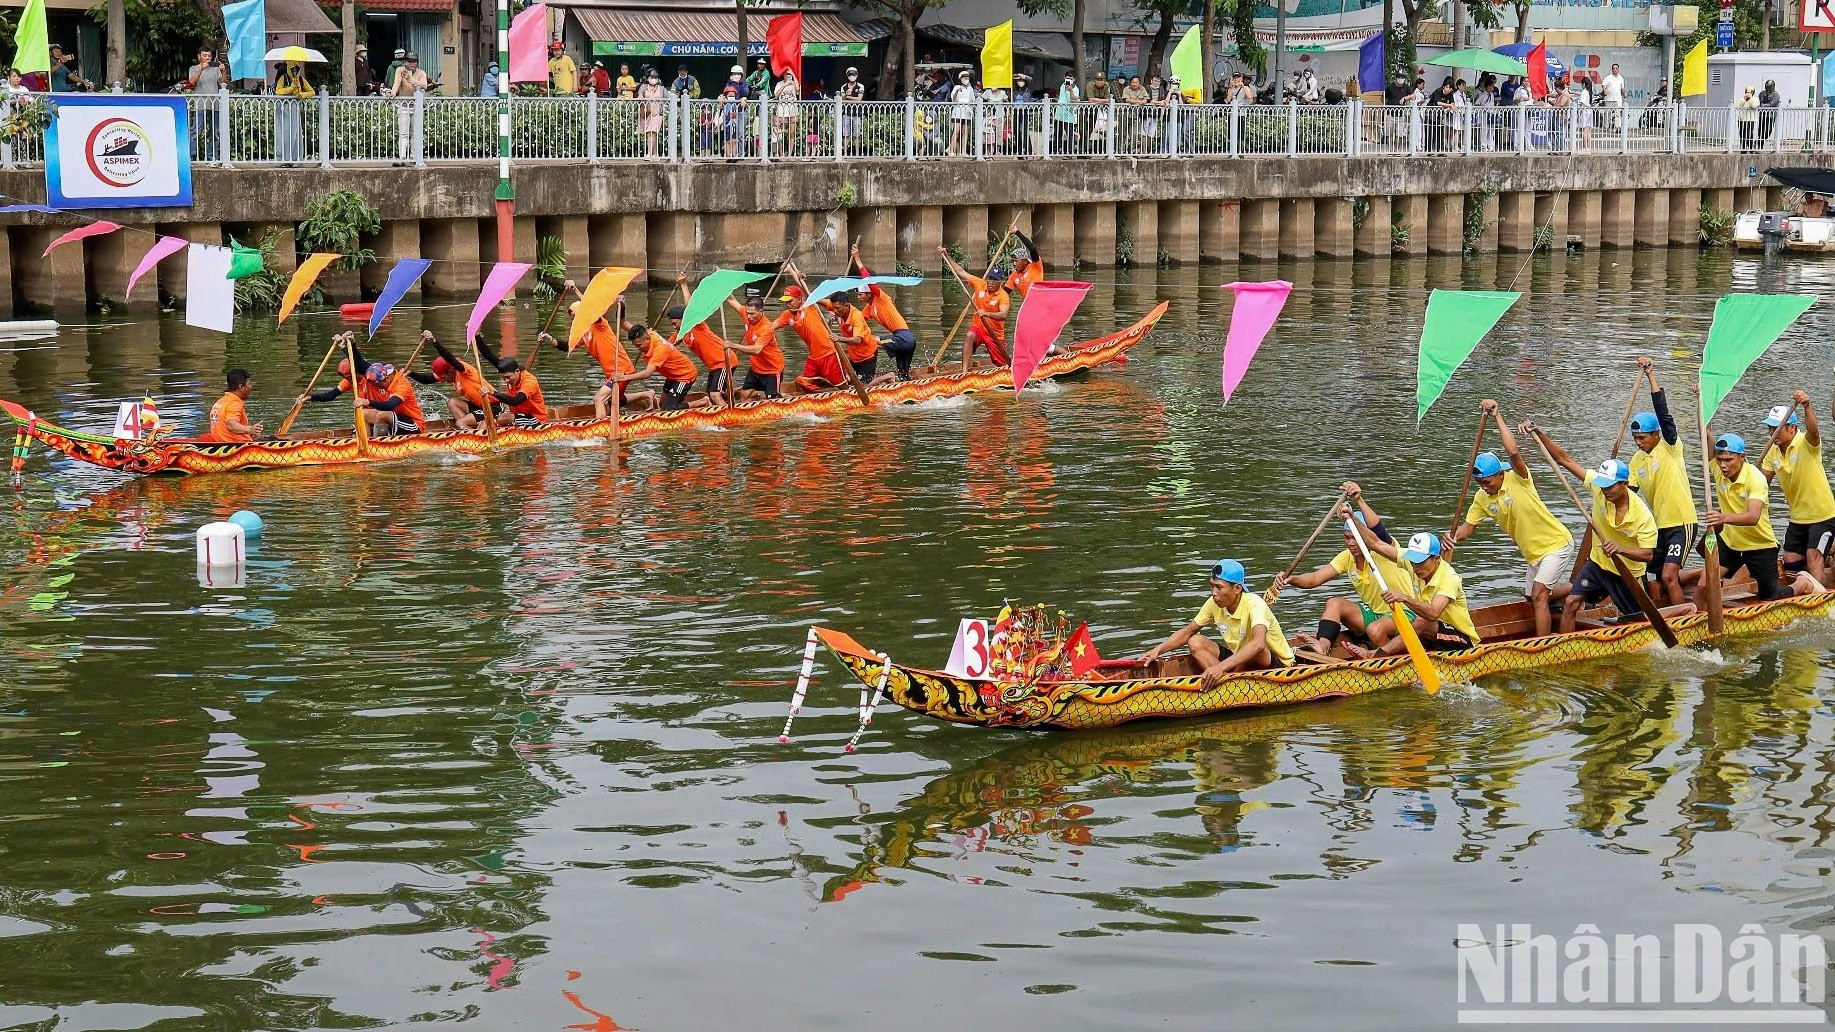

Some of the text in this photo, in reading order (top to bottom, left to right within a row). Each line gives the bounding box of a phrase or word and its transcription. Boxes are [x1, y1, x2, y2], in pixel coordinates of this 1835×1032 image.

[671, 43, 691, 54] CHÚ
[692, 43, 715, 54] NĂM
[103, 157, 140, 165] ASPIMEX
[122, 403, 141, 439] 4
[1667, 544, 1681, 557] 23
[966, 621, 988, 678] 3
